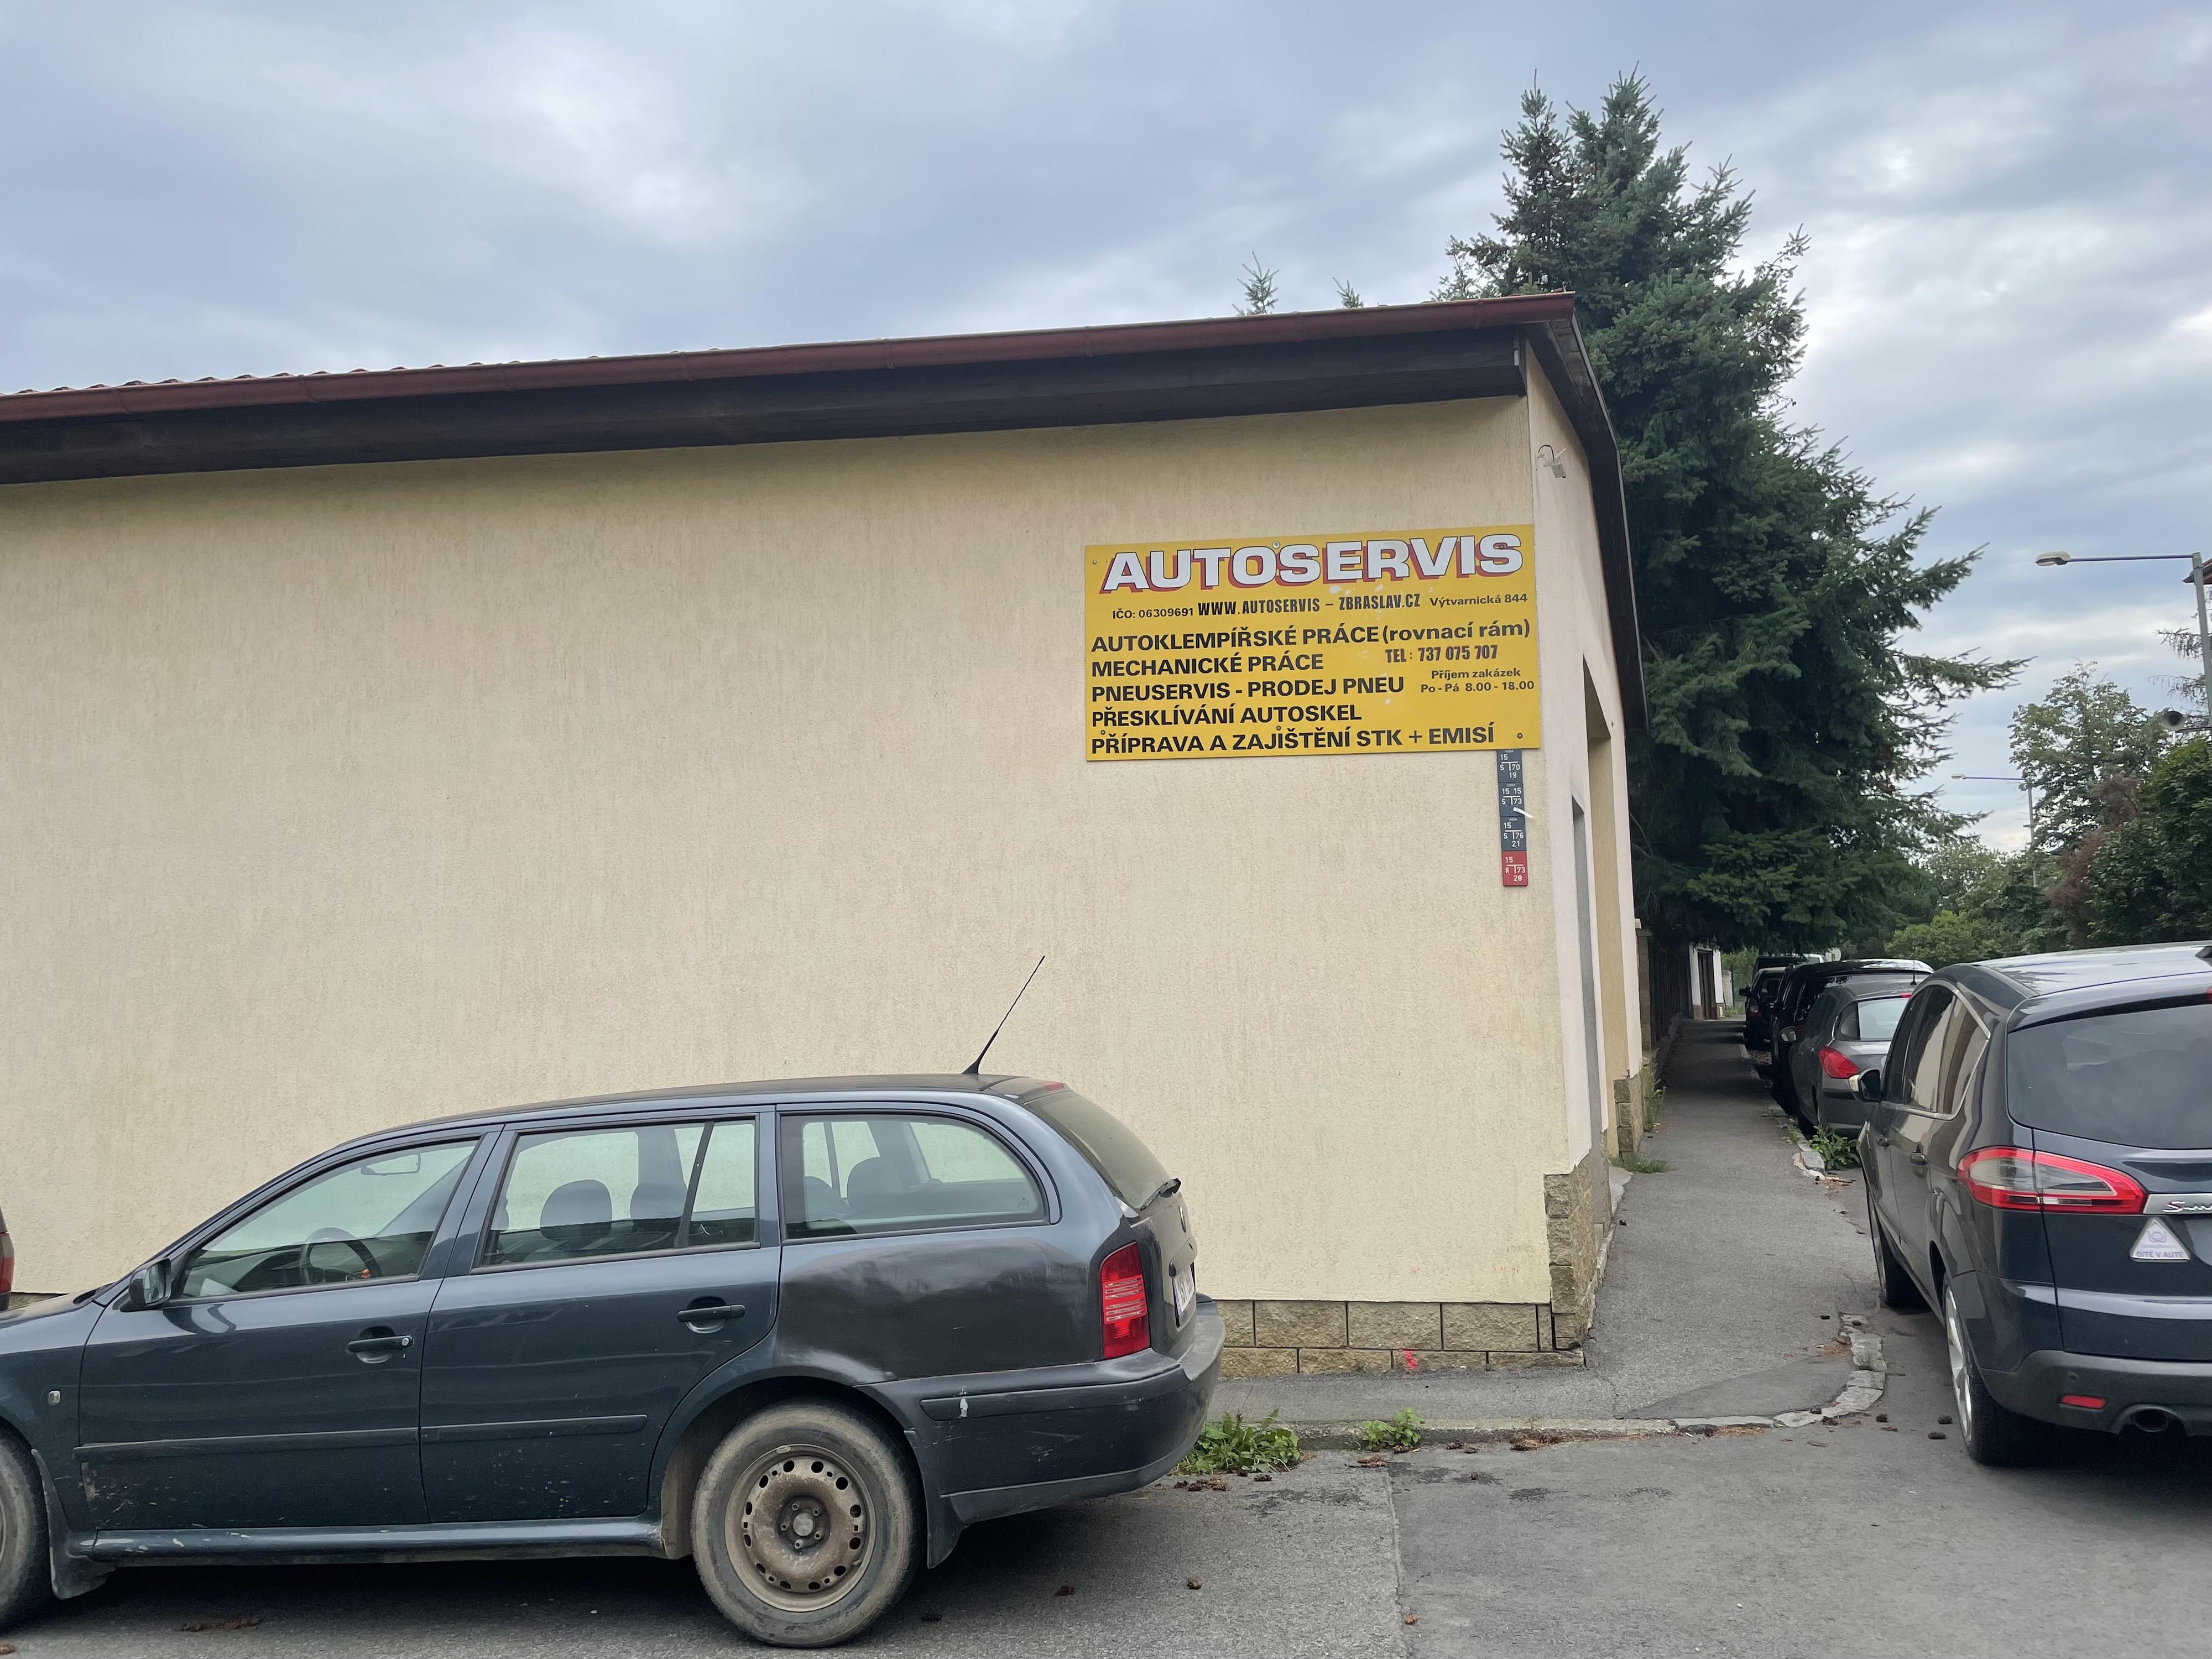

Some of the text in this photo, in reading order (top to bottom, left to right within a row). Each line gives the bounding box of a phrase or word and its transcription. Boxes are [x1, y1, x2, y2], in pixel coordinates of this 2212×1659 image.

[1099, 534, 1523, 593] AUTOSERVIS
[1113, 608, 1135, 619] IČO:
[1139, 608, 1193, 618] 06309691
[1339, 593, 1420, 610] ZBRASLAV.CZ
[1430, 594, 1501, 608] Výtvarnická
[1504, 593, 1527, 603] 844
[1092, 619, 1530, 652] AUTOKLEMPÍŘSKÉ PRÁCE (rovnací rám)
[1092, 650, 1323, 677] MECHANICKÉ PRÁCE
[1418, 647, 1441, 661] 737
[1446, 646, 1470, 660] 075
[1475, 645, 1498, 659] 707
[1432, 668, 1520, 680] Příjem zakázek
[1465, 683, 1491, 691] 8.00
[1502, 681, 1534, 690] 18.00
[1092, 682, 1230, 702] PNEUSERVIS
[1248, 679, 1336, 697] PRODEJ
[1343, 677, 1404, 694] PNEU
[1092, 703, 1361, 727] PŘESKLÍVÁNÍ AUTOSKEL
[1092, 722, 1495, 754] PŘÍPRAVA A ZAJIŠTĚNÍ STK + EMISÍ
